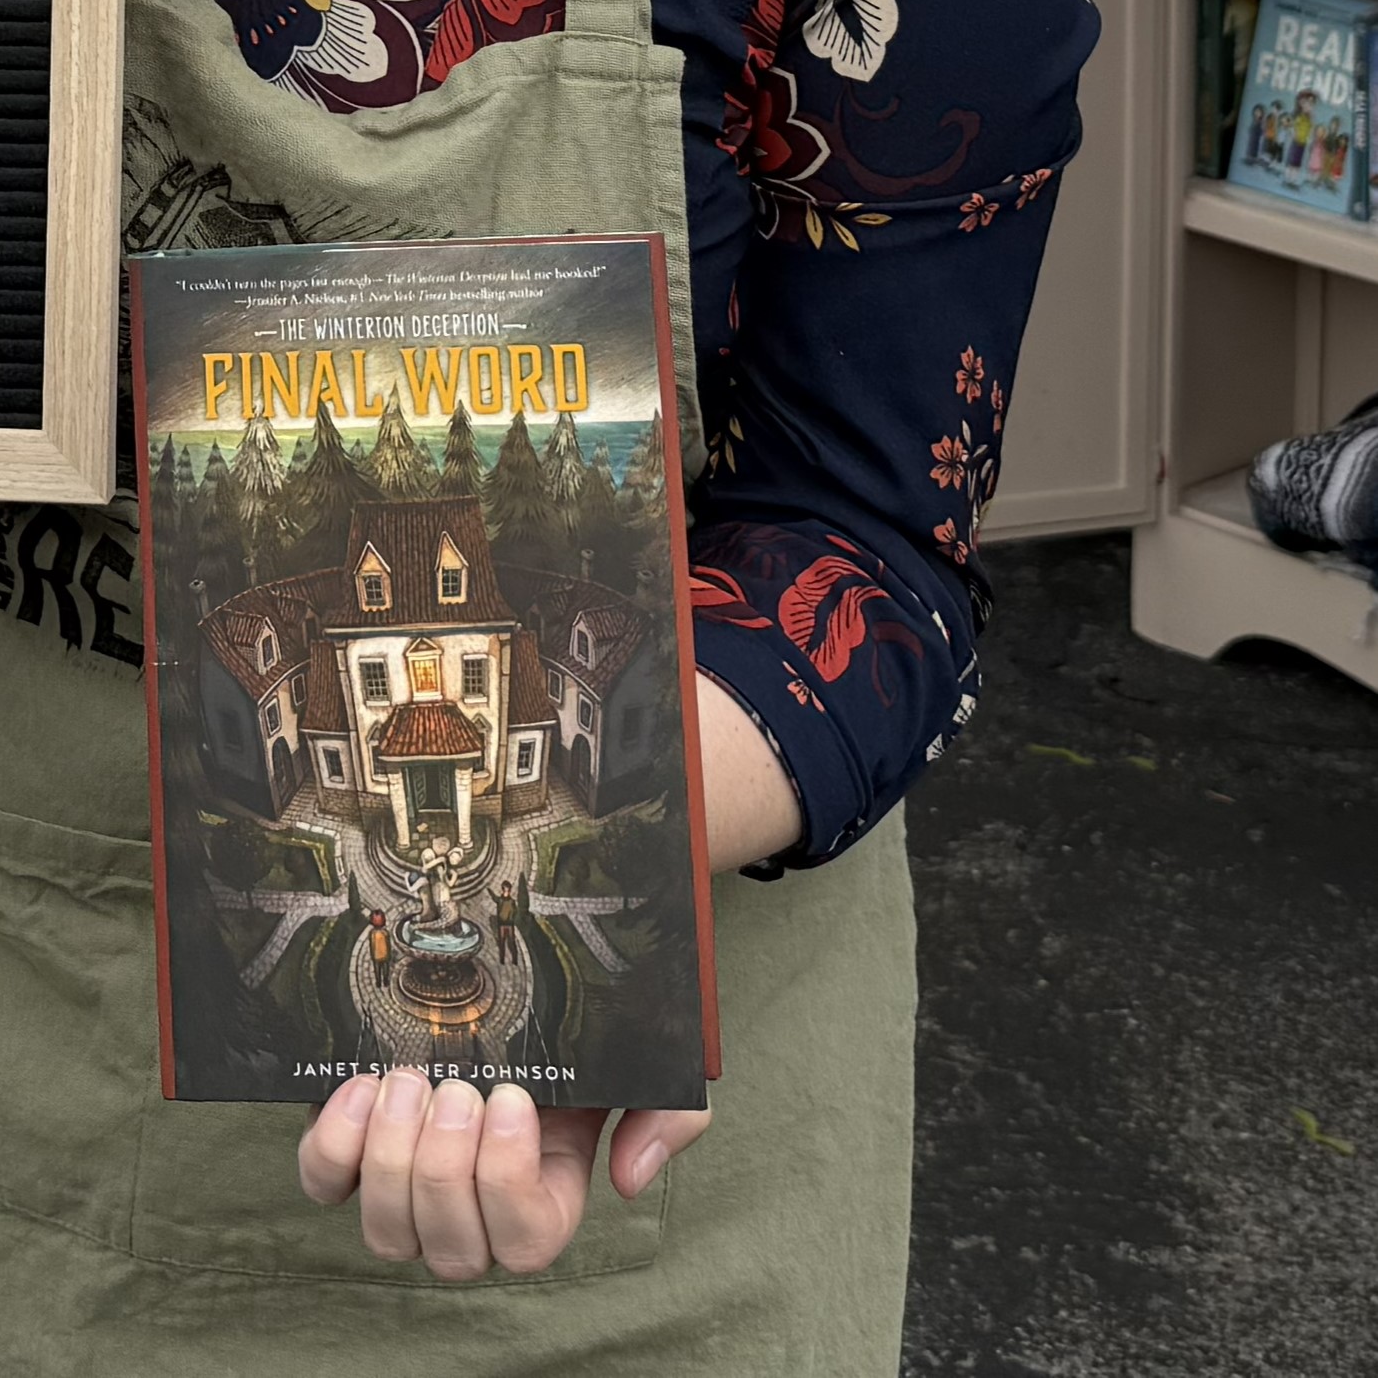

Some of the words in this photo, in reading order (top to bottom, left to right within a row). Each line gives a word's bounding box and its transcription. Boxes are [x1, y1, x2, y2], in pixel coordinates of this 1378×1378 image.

[260, 277, 277, 289] the
[280, 279, 308, 291] pages
[279, 318, 306, 341] THE
[314, 314, 405, 341] WINTERTON
[412, 311, 500, 338] DECEPTION
[202, 348, 384, 420] FINAL
[399, 342, 589, 414] WORD
[293, 1061, 360, 1078] JANET
[369, 1061, 460, 1078] SUNER
[470, 1063, 576, 1082] JOHNSON
